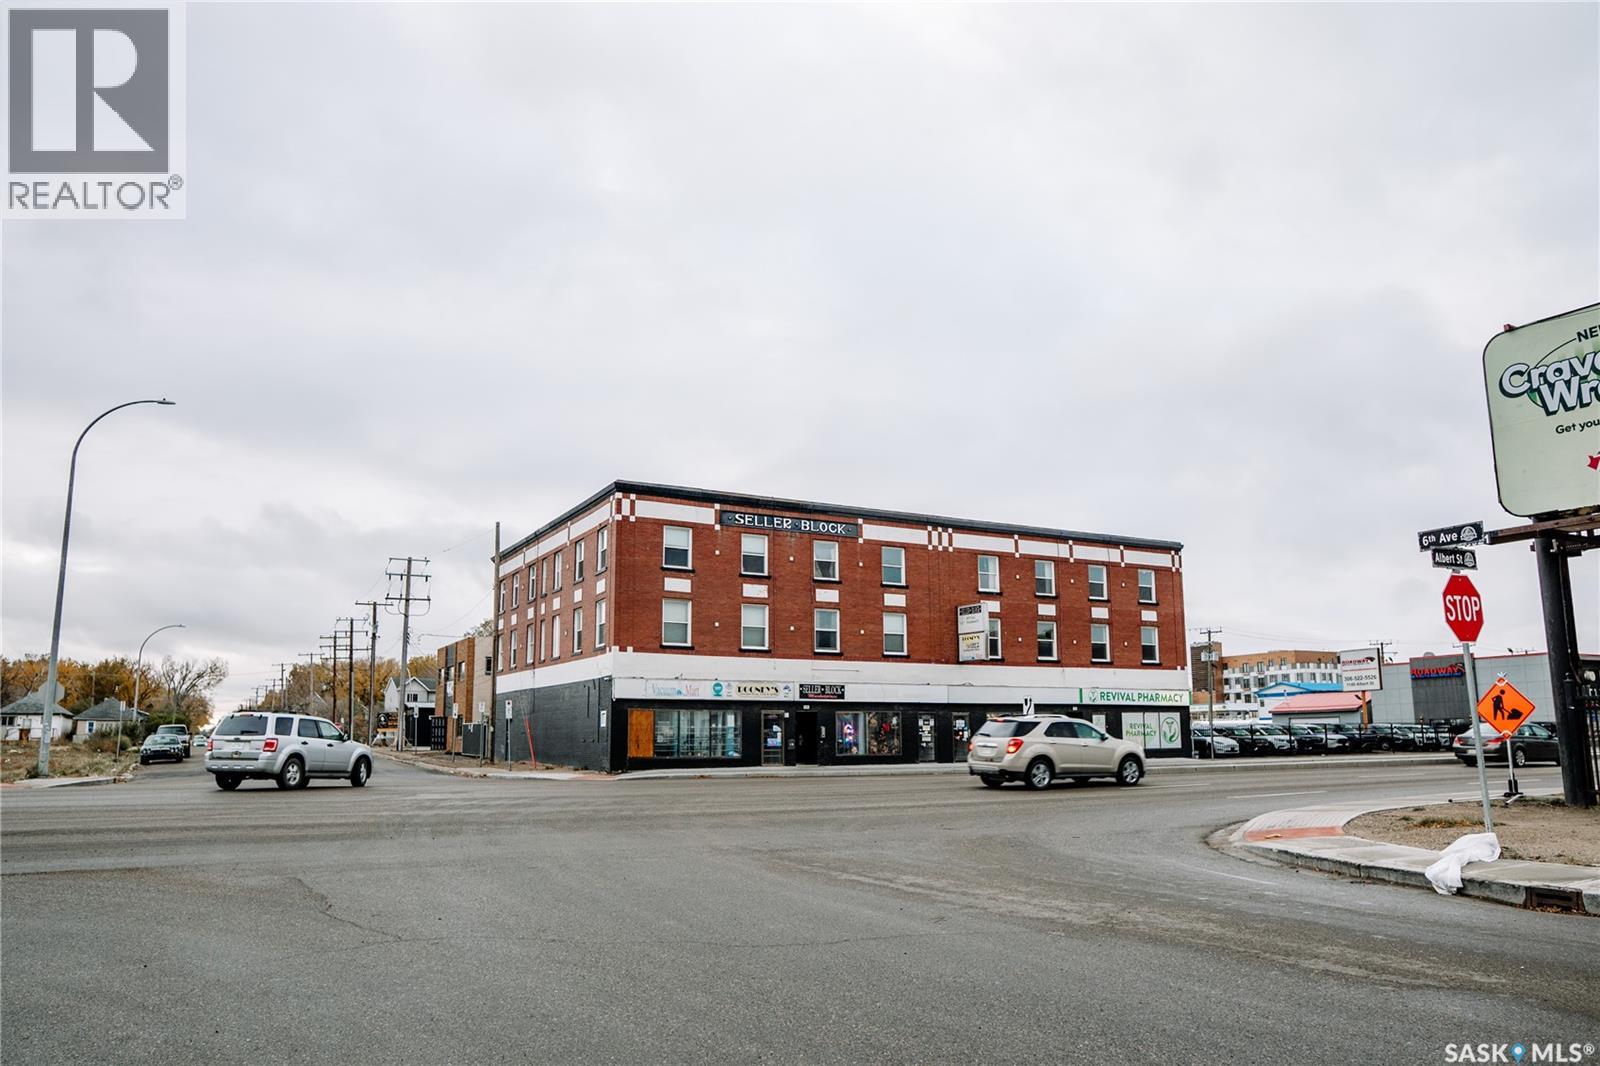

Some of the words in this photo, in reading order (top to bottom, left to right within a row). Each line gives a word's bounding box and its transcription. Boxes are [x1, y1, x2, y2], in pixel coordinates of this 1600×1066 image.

[1577, 325, 1600, 343] NE
[1540, 376, 1600, 416] Wr
[1555, 424, 1577, 434] Get
[734, 513, 792, 529] SELLER
[801, 519, 847, 535] BLOCK
[1422, 535, 1437, 547] 6th
[1439, 532, 1458, 544] Ave
[1435, 552, 1455, 564] Albert
[1456, 553, 1464, 565] St
[1445, 595, 1481, 622] STOP
[1100, 691, 1136, 703] REVIVAL
[1138, 692, 1184, 703] PHARMACY
[1129, 722, 1153, 730] REVIVAL
[1126, 730, 1157, 738] PHARMACY
